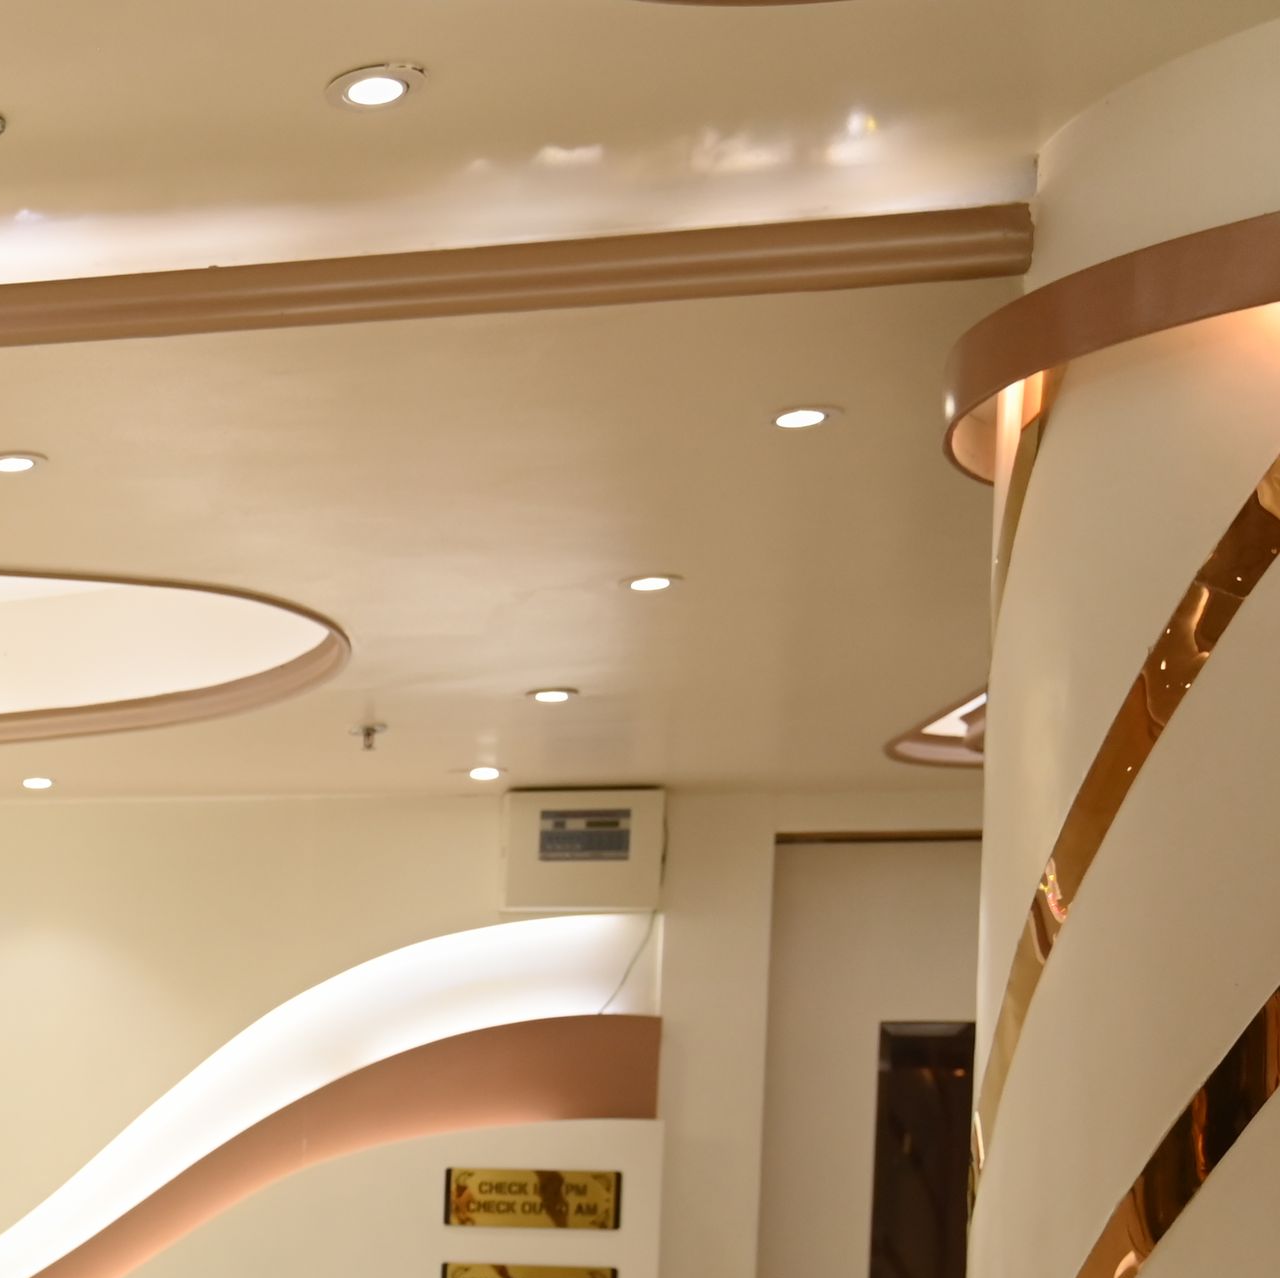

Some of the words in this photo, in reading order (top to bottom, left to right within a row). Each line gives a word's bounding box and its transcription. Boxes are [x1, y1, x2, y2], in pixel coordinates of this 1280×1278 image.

[478, 1181, 528, 1196] CHECK
[565, 1183, 588, 1197] PM
[466, 1199, 517, 1215] CHECK
[574, 1202, 598, 1216] AM
